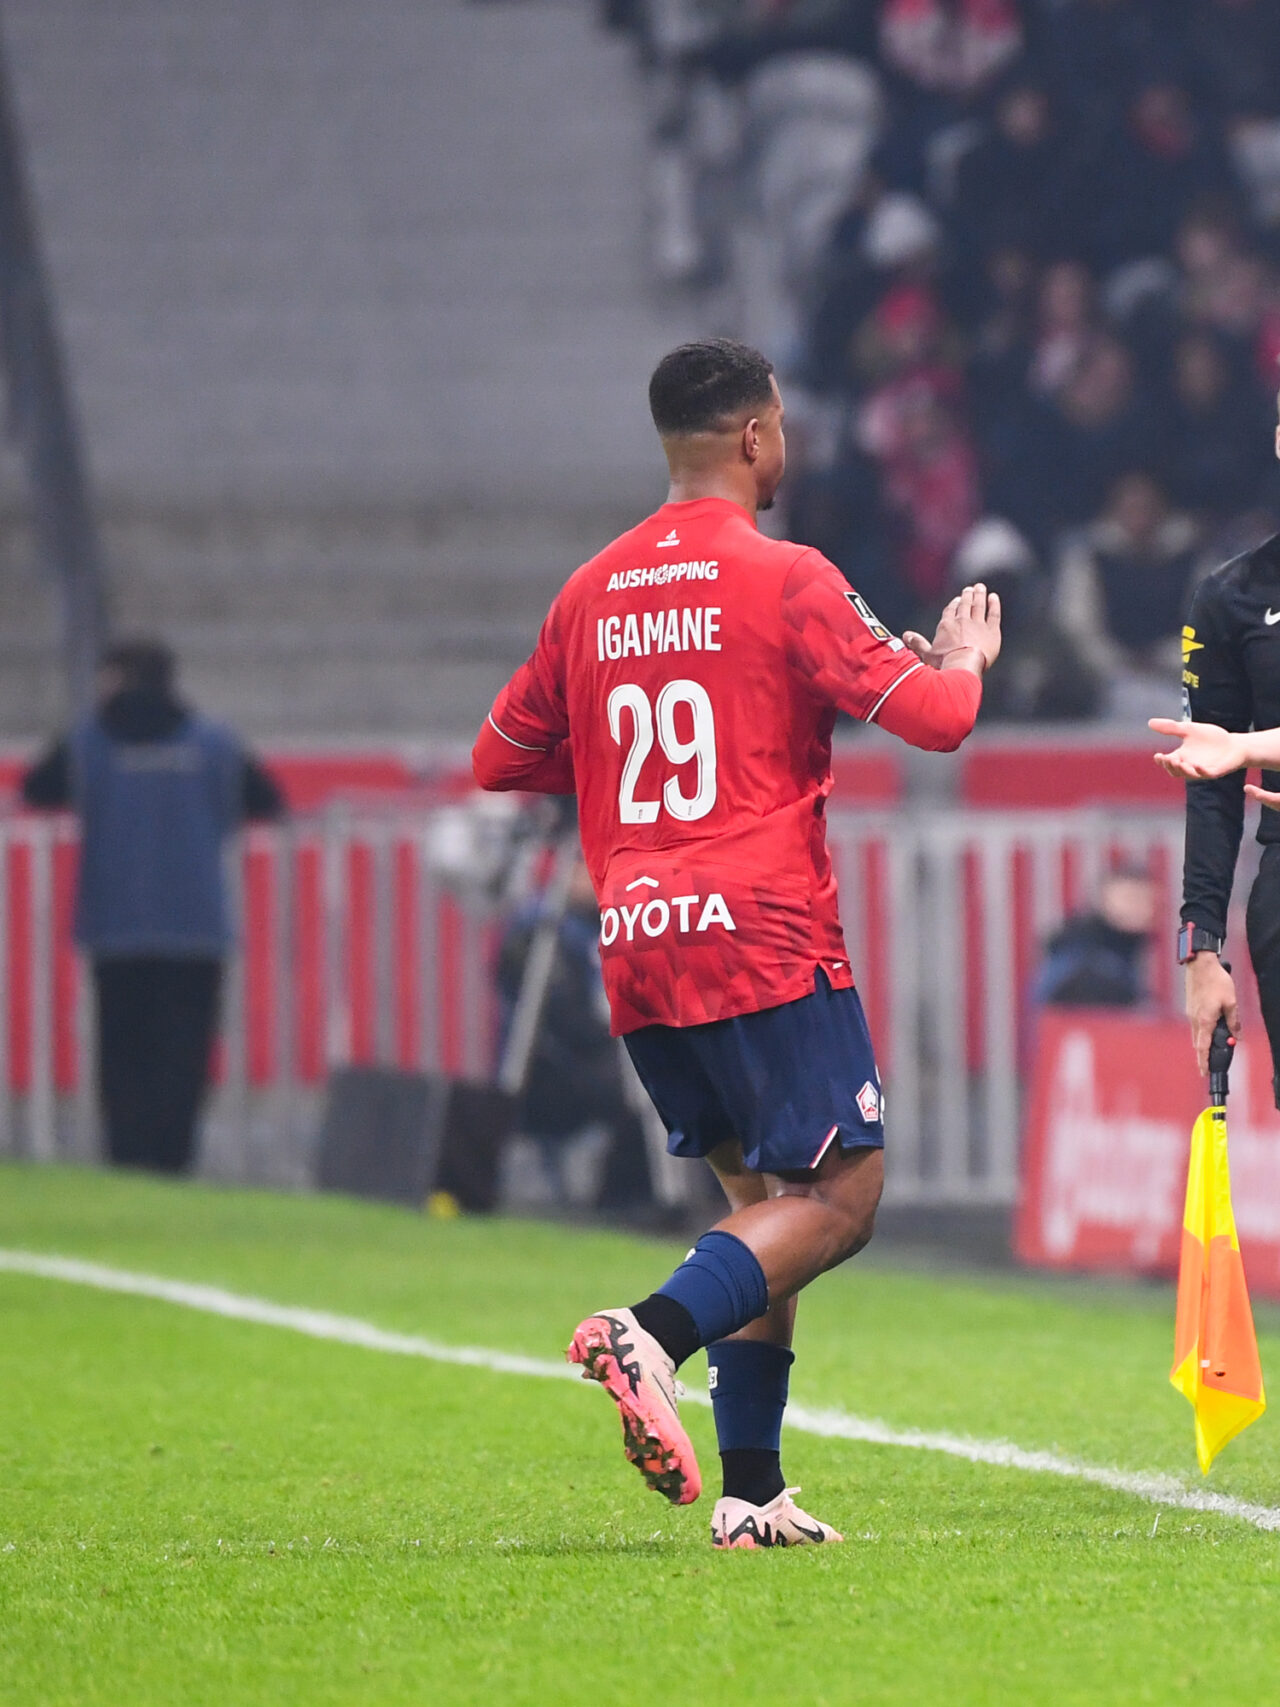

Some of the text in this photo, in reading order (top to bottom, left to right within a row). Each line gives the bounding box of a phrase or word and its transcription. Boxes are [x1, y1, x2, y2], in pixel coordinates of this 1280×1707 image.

[606, 560, 719, 592] AUSHOPPING
[597, 607, 722, 661] IGAMANE
[607, 679, 717, 824] 29
[600, 893, 737, 947] OYOTA
